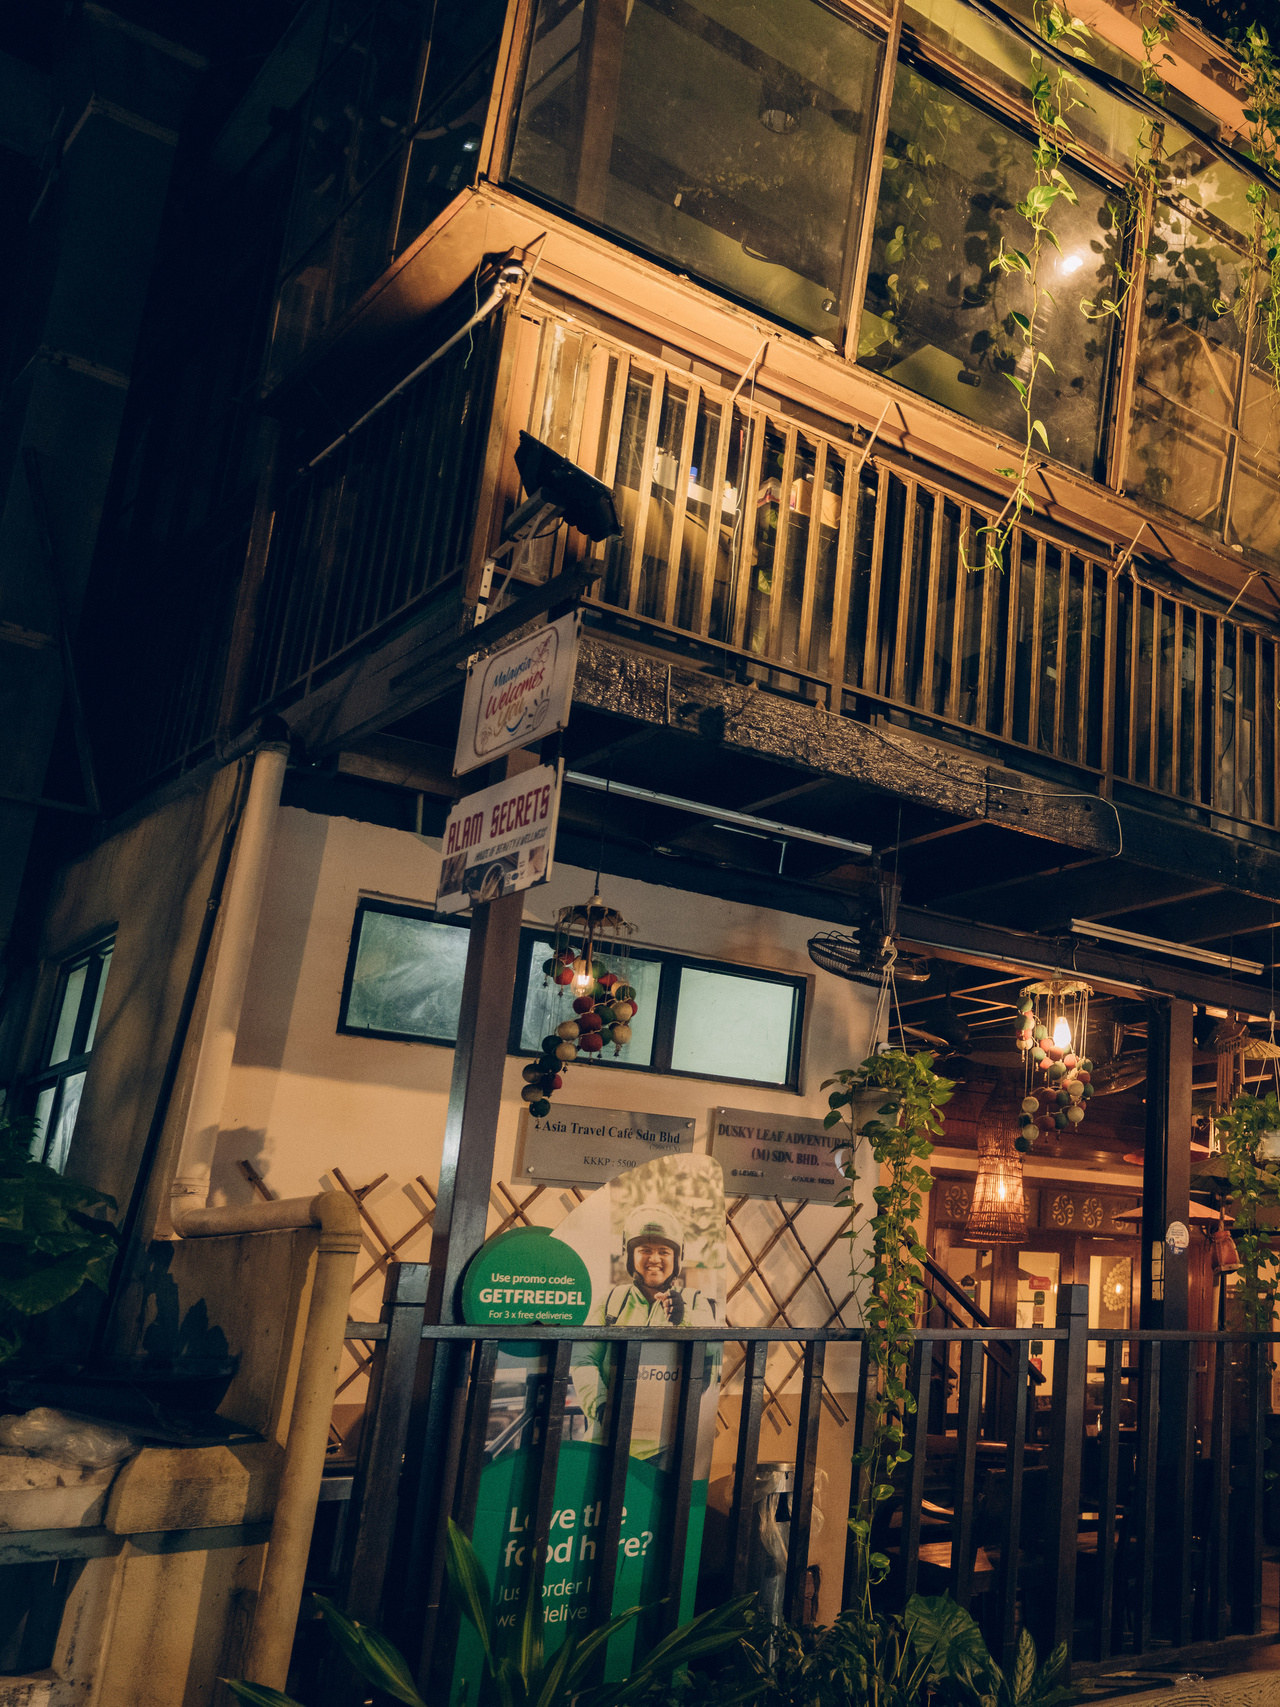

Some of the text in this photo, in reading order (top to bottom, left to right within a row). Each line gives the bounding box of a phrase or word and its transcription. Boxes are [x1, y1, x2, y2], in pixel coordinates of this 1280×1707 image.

[494, 656, 532, 687] Malaysia
[446, 784, 551, 855] ALAM SECRETS
[542, 1120, 567, 1133] Asia
[570, 1122, 605, 1137] Travel
[608, 1126, 633, 1140] Café
[636, 1130, 656, 1142] Sdn
[659, 1131, 680, 1144] Bhd
[718, 1123, 754, 1140] DUSKY
[756, 1128, 784, 1142] LEAF
[583, 1156, 610, 1166] KKKP
[617, 1158, 637, 1168] 5500
[796, 1152, 820, 1167] BHD.
[491, 1273, 576, 1285] Use promo code:
[479, 1288, 586, 1306] GETFREEDEL
[489, 1310, 502, 1319] For
[504, 1310, 509, 1319] 3
[518, 1311, 534, 1319] free
[535, 1311, 573, 1320] deliveries
